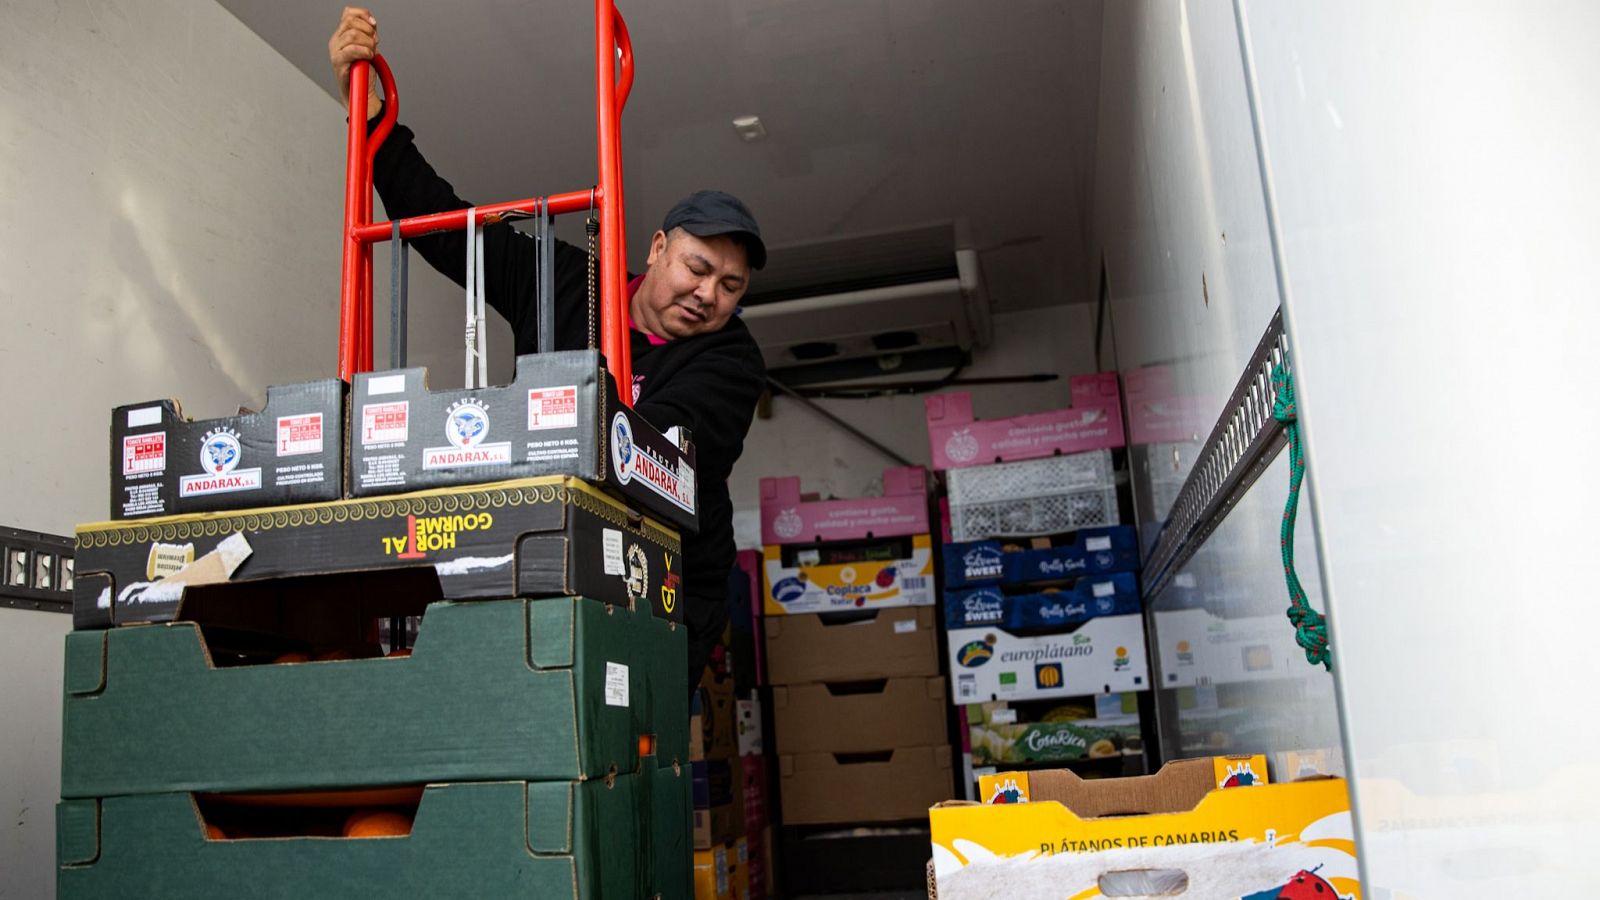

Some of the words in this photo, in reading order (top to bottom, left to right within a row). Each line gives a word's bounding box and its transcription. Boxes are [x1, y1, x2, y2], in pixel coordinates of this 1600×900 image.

[445, 397, 490, 414] FRUTAS
[200, 426, 241, 443] FRUTAS
[1008, 424, 1053, 436] contiene
[992, 436, 1031, 450] calidad
[1033, 439, 1039, 447] y
[1041, 431, 1077, 444] mucho
[1079, 428, 1108, 439] amor
[429, 450, 493, 465] ANDARAX,
[186, 476, 245, 493] ANDARAX,
[635, 453, 680, 500] ANDARAX,
[829, 508, 868, 518] contiene
[814, 517, 849, 530] calidad
[850, 519, 855, 528] y
[857, 514, 889, 526] mucho
[890, 514, 916, 523] amor
[965, 564, 1003, 578] SWEET
[826, 584, 872, 597] Coplaca
[965, 609, 1003, 622] SWEET
[1073, 633, 1091, 646] Bio
[1000, 643, 1094, 665] europlátano
[1040, 837, 1122, 856] PLÁTANOS
[1128, 836, 1148, 849] DE
[1153, 829, 1239, 847] CANARIAS
